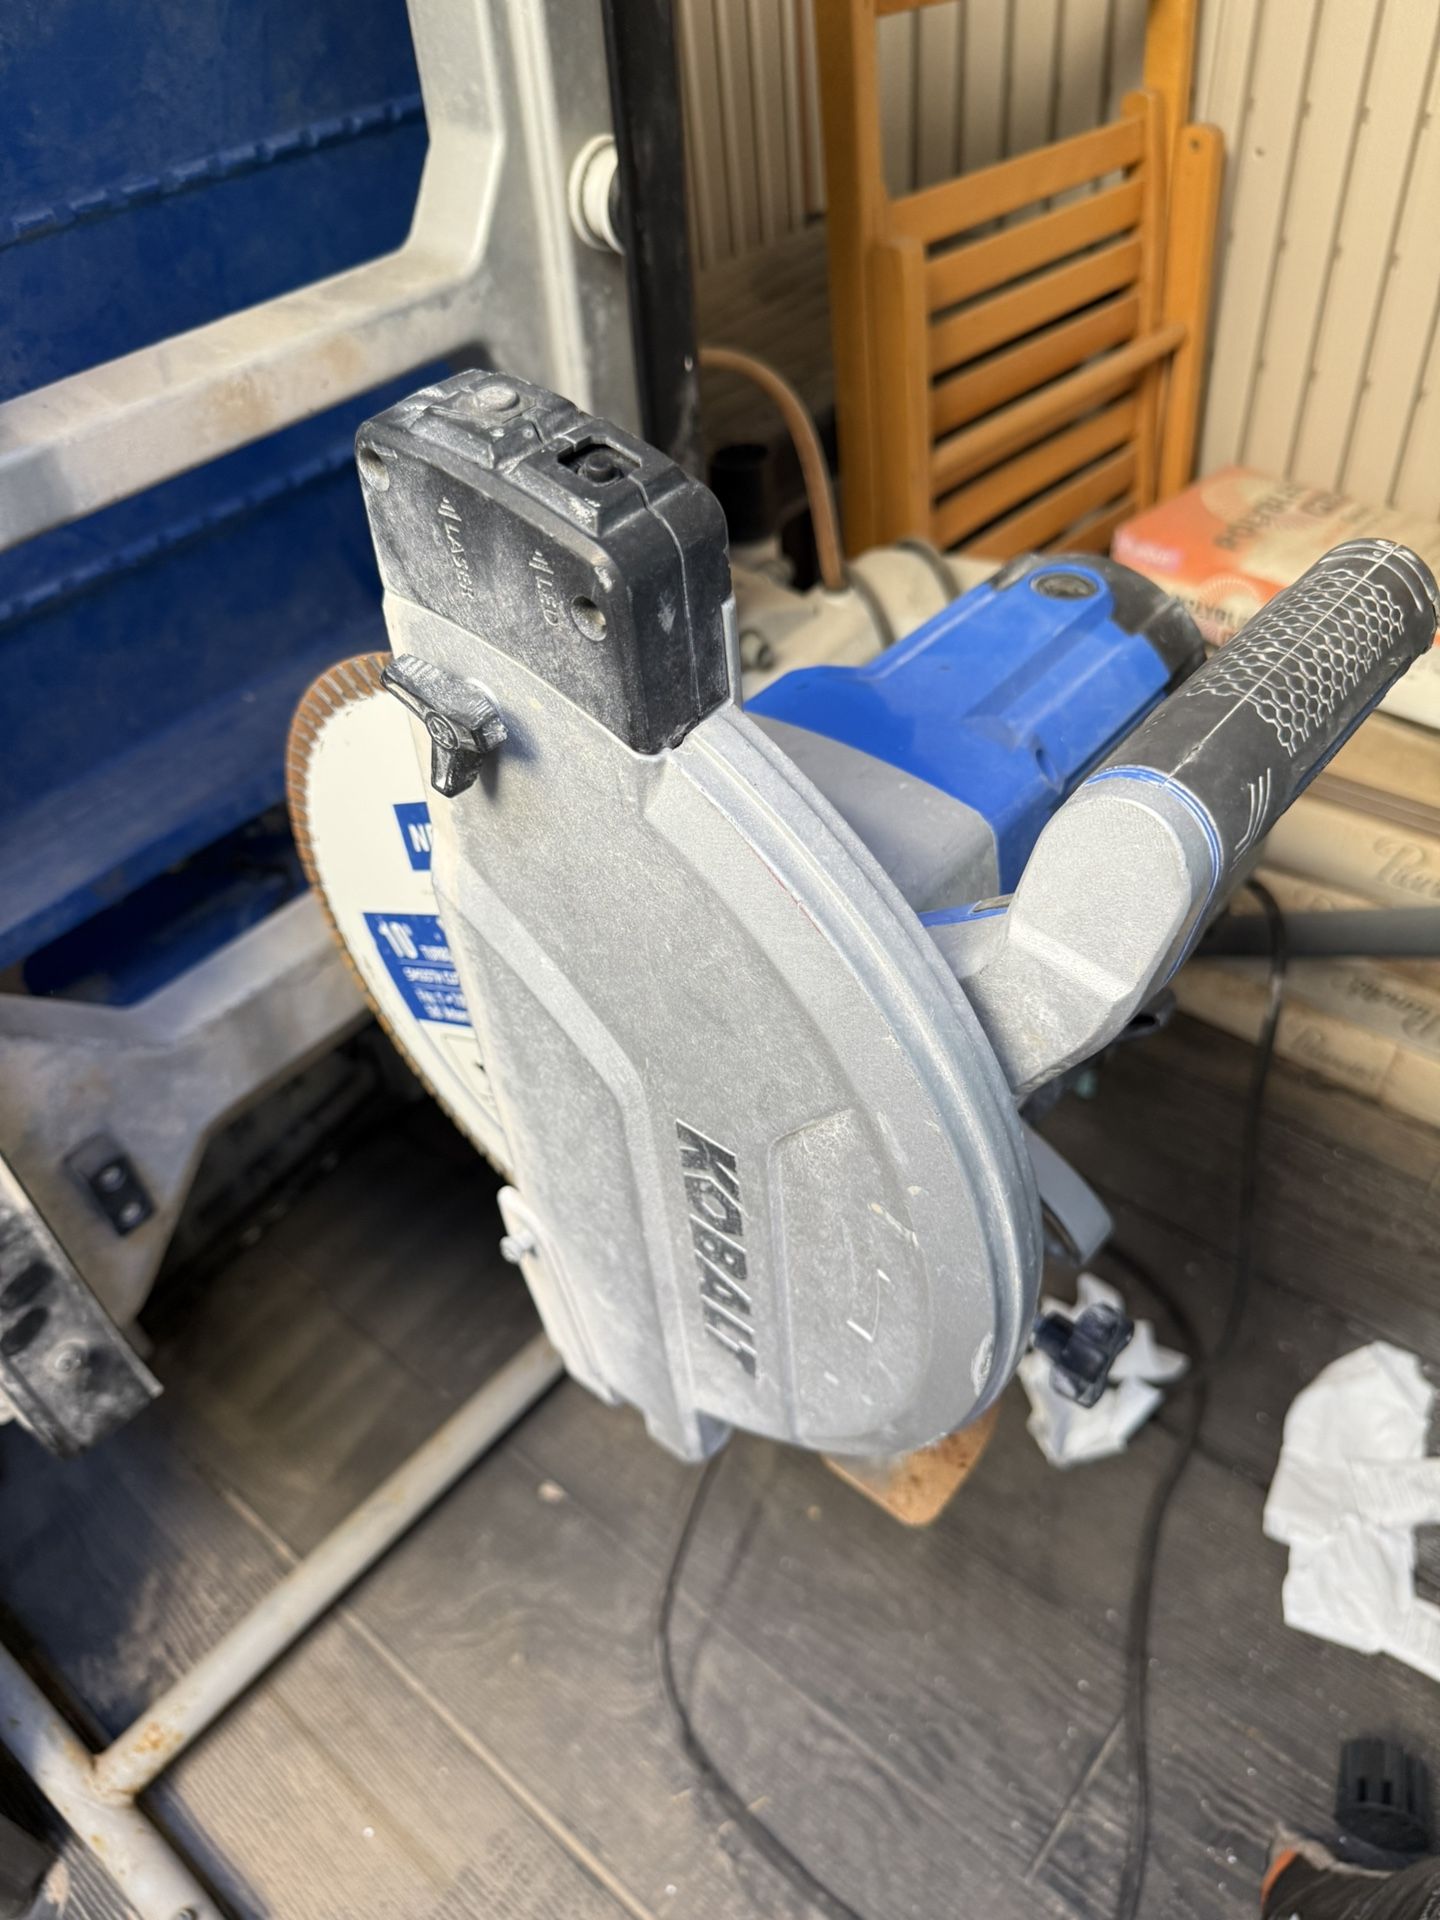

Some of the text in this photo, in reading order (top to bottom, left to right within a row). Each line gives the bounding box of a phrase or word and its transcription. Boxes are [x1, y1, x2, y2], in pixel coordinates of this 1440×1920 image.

[443, 521, 475, 600] LASER
[535, 575, 560, 626] LED
[676, 1118, 757, 1379] KOBALT
